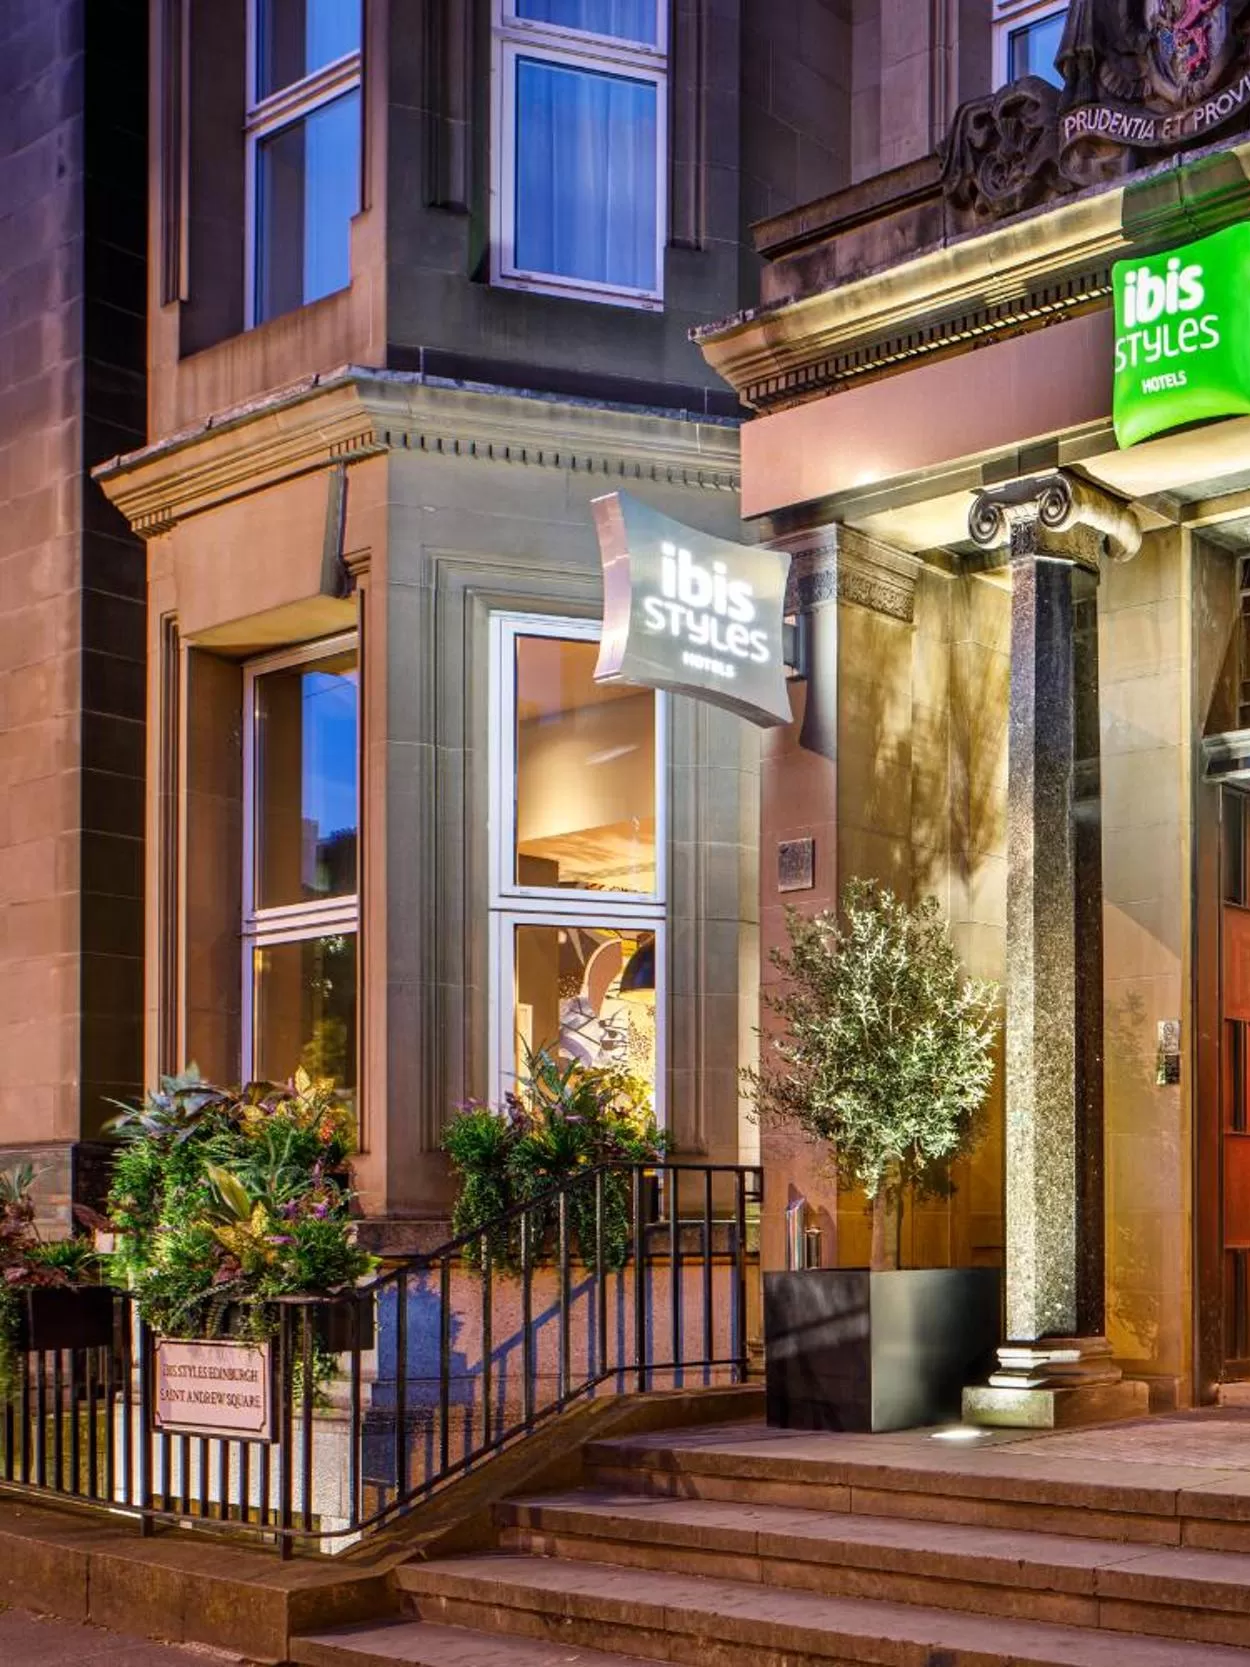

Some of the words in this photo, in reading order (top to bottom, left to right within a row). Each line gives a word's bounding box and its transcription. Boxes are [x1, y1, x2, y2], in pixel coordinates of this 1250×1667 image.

[1064, 107, 1154, 141] PRUDENTIA
[1163, 117, 1184, 137] ET
[1124, 257, 1204, 327] ibis
[1141, 370, 1187, 394] HOTELS
[660, 541, 756, 622] ibis
[681, 651, 736, 678] HOTELS
[177, 1364, 208, 1379] STYLES
[208, 1367, 258, 1382] EDINBURGH
[160, 1388, 186, 1402] SAINT
[186, 1390, 226, 1404] ANDREW
[226, 1393, 261, 1409] SQUARE
